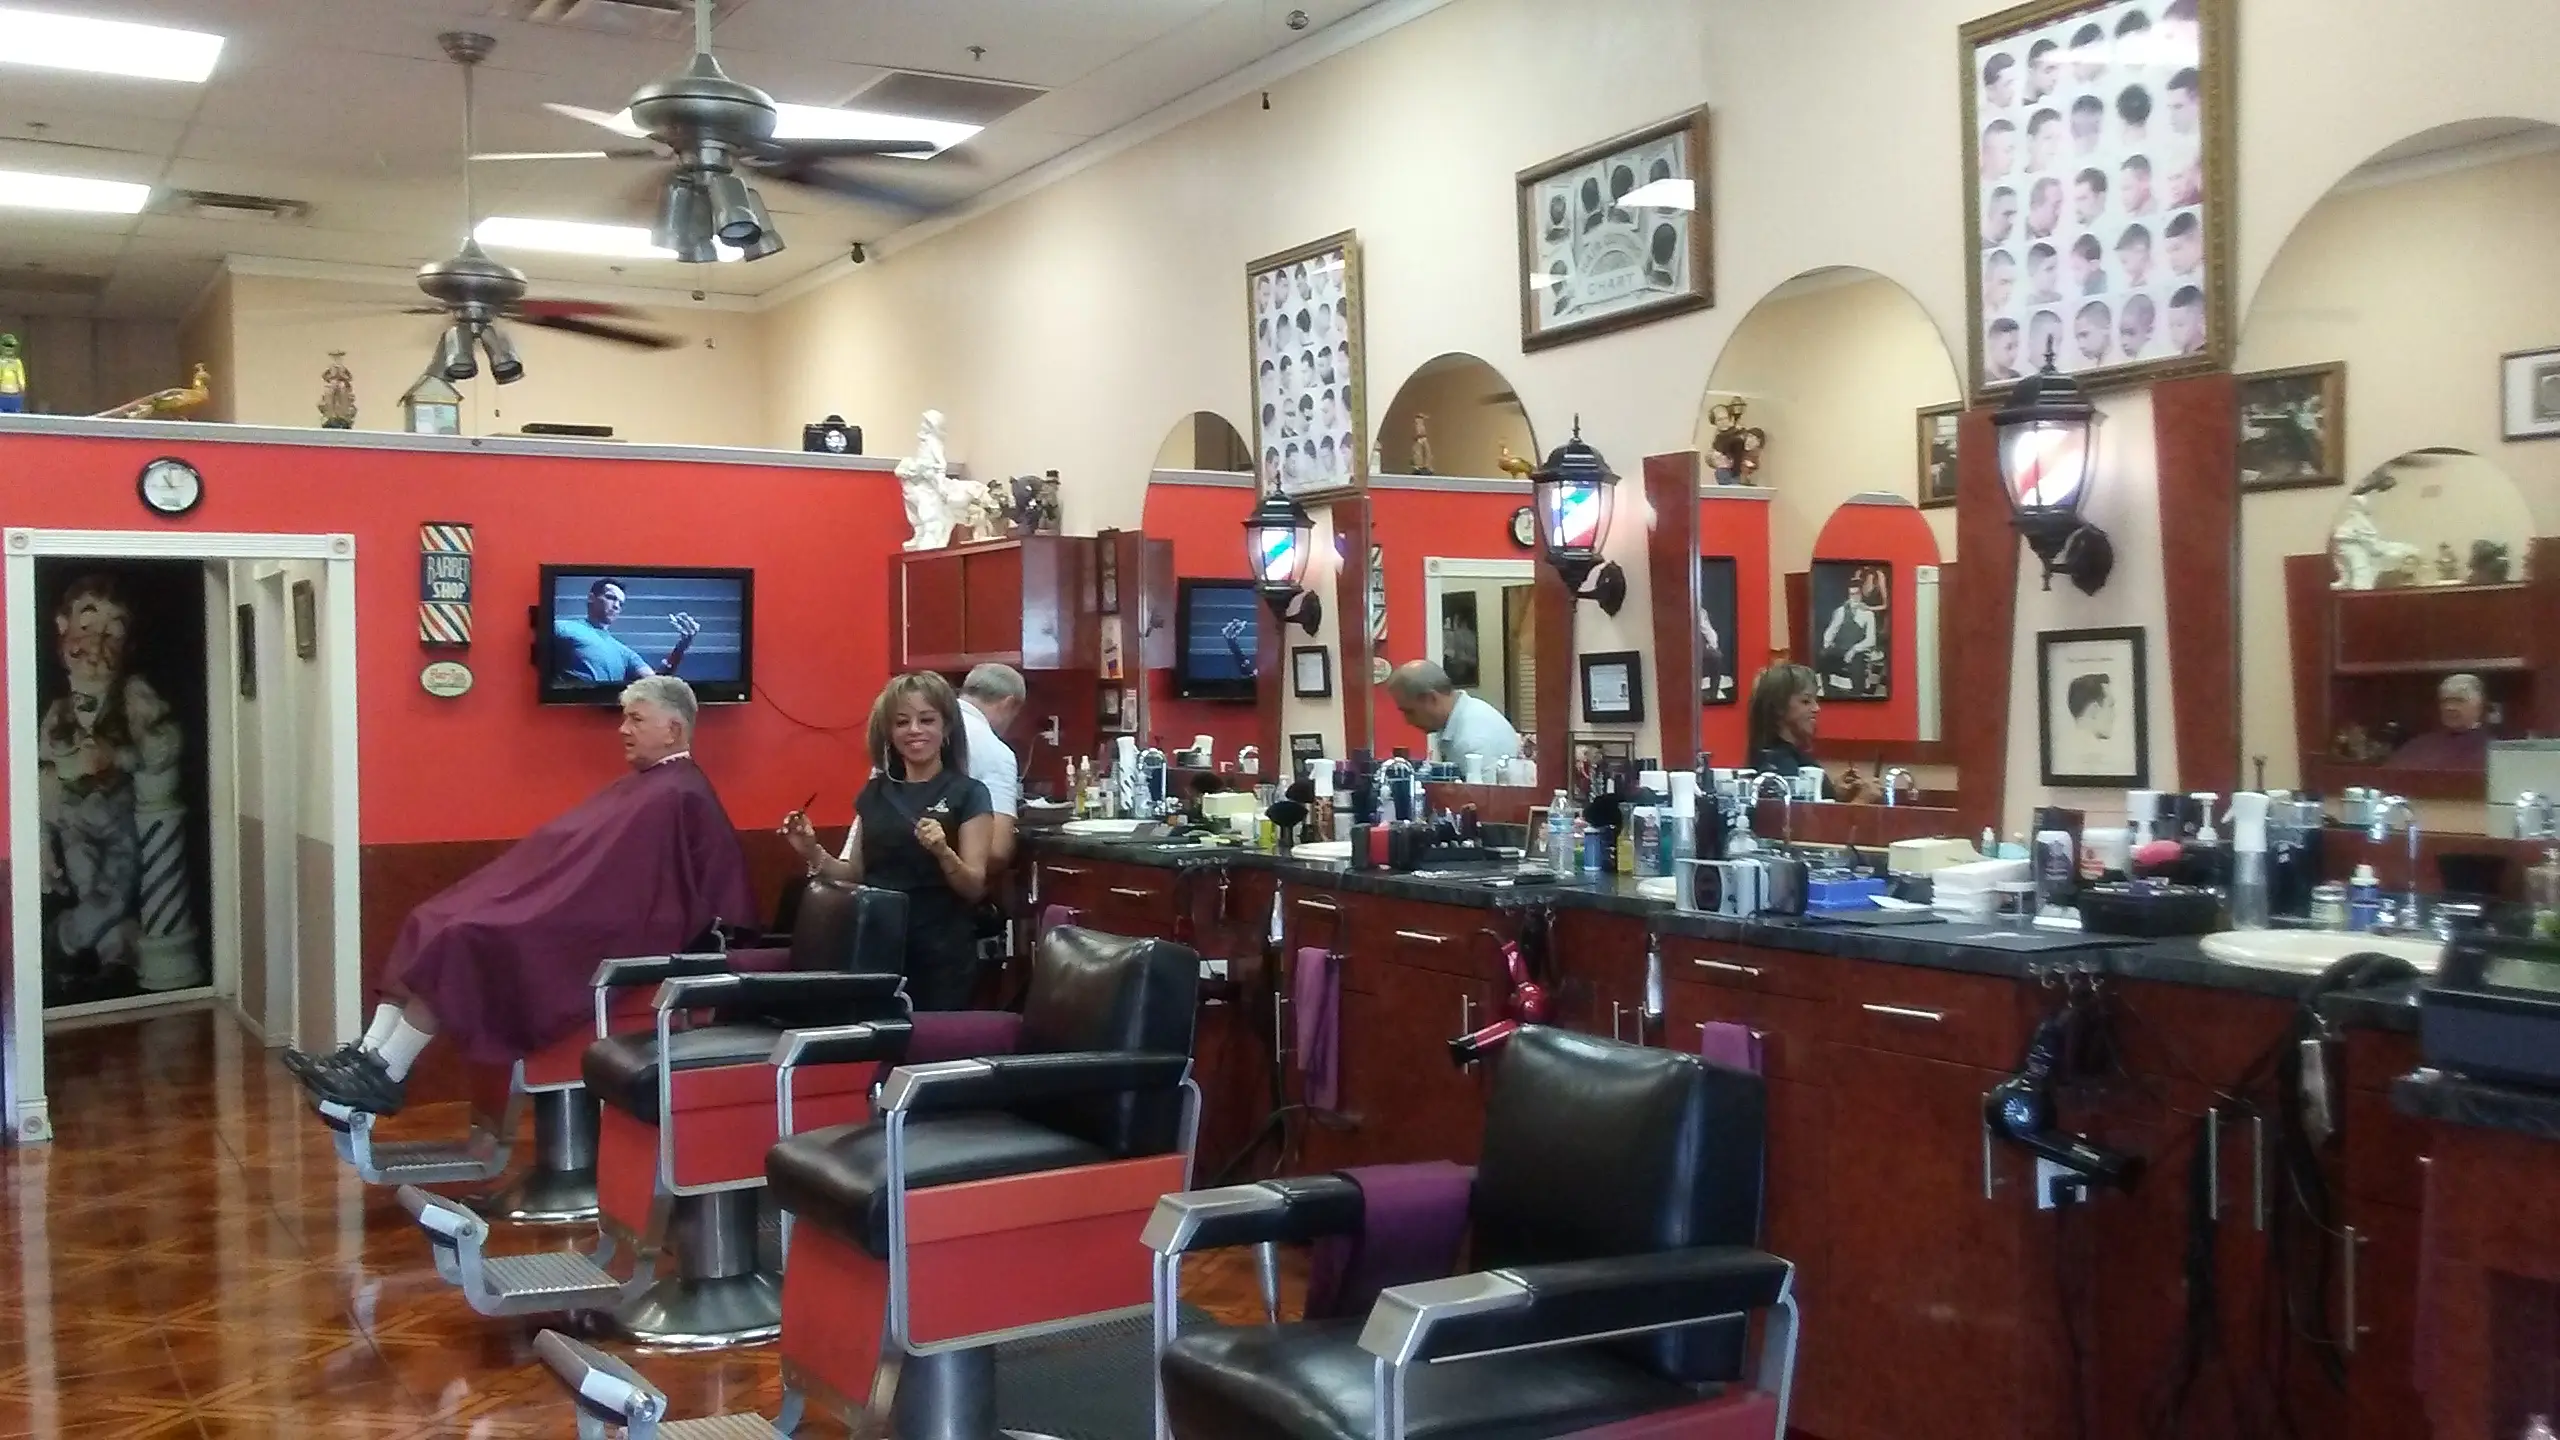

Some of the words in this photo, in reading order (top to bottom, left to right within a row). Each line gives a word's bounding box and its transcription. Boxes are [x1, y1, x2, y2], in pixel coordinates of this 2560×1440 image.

[1587, 272, 1635, 296] CHART
[427, 555, 471, 587] BARBER
[432, 581, 466, 599] SHOP
